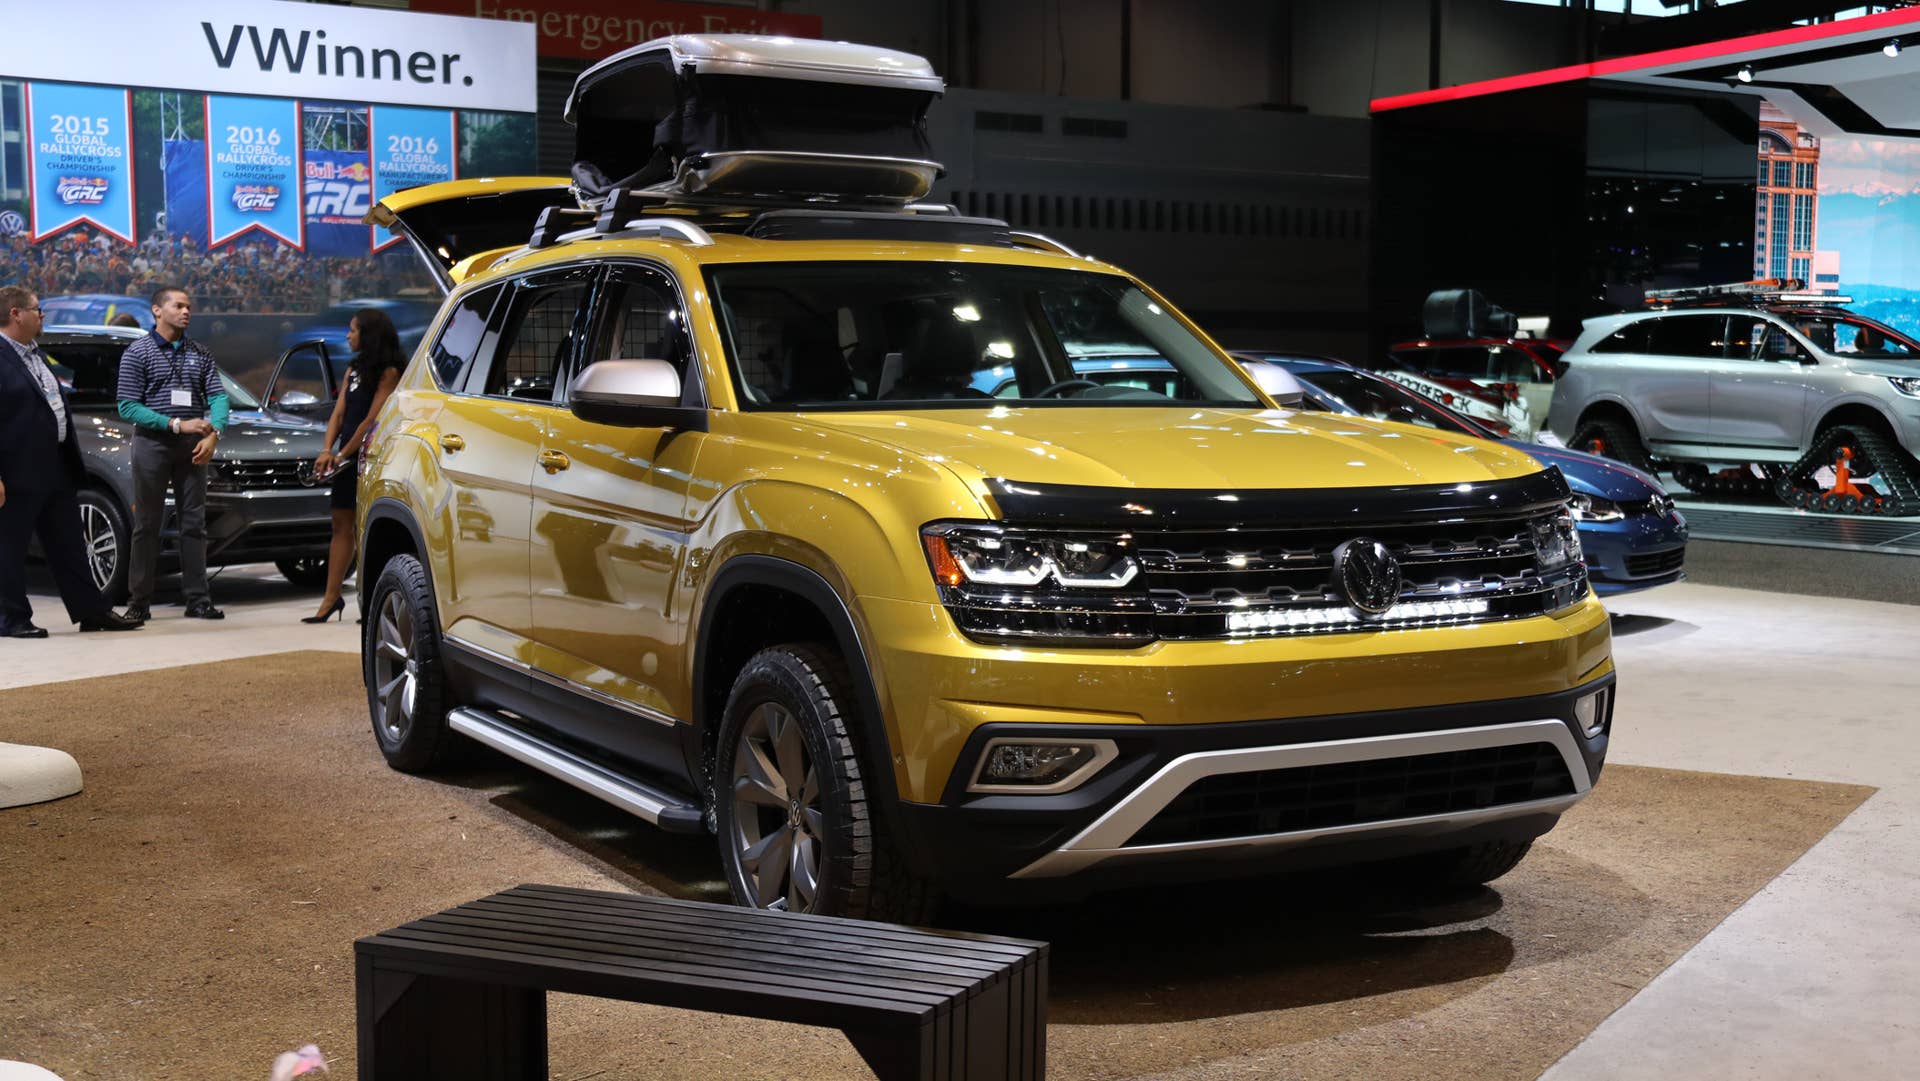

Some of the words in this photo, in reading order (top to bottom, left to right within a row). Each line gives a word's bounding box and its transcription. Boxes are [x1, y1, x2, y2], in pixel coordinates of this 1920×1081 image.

[200, 21, 474, 87] VWinner.
[50, 115, 109, 136] 2015
[55, 133, 107, 146] GLOBAL
[226, 126, 281, 146] 2016
[40, 143, 122, 157] RALLYCROSS
[230, 143, 278, 155] GLOBAL
[387, 135, 439, 154] 2016
[60, 155, 102, 163] DRIVER'S
[217, 152, 292, 166] RALLYCROSS
[391, 153, 436, 164] GLOBAL
[46, 162, 117, 172] CHAMPIONSHIP
[305, 161, 335, 179] Bull
[379, 161, 449, 174] RALLYCROSS
[222, 171, 286, 180] CHAMPIONSHIP
